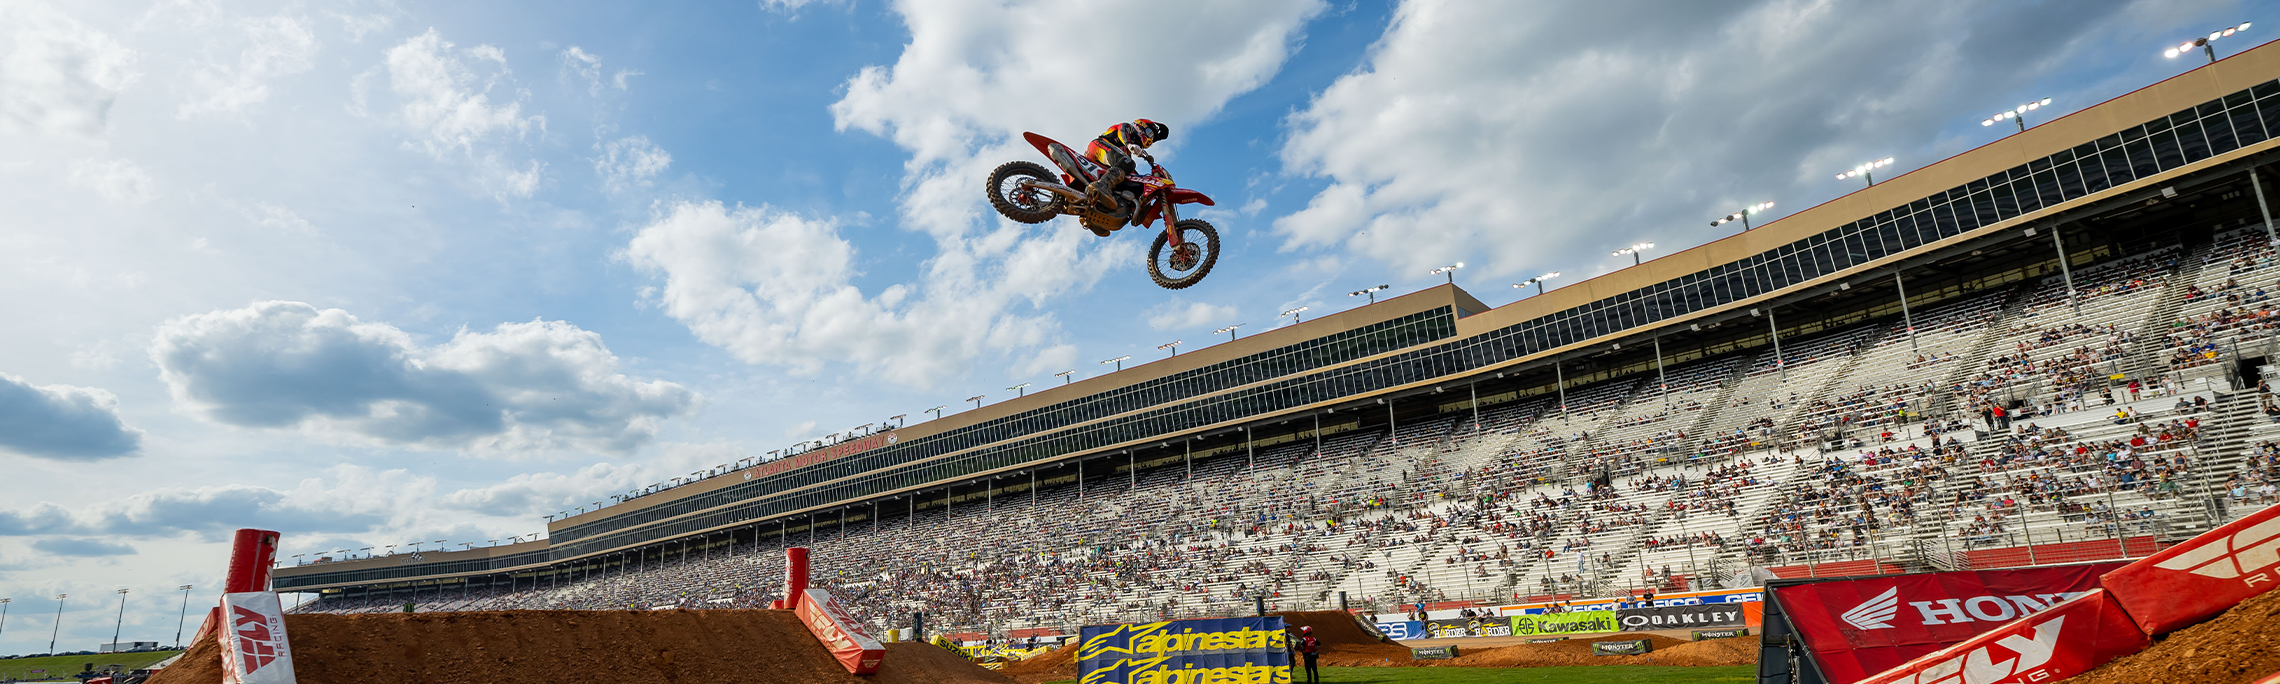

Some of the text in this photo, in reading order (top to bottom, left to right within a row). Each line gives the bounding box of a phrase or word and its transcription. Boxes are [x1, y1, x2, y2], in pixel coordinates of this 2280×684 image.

[754, 436, 885, 478] ATLANTA MOTOR SPEEDWAY
[1651, 611, 1739, 625] OAKLEY
[1909, 591, 2086, 626] HON
[1434, 627, 1467, 639] HARDER
[1474, 625, 1512, 638] HARDER
[1538, 617, 1612, 634] Kawasaki
[233, 604, 276, 675] FLY
[269, 616, 287, 658] RACING
[1136, 626, 1286, 662] alpinestars
[1601, 643, 1634, 651] MONSTER
[939, 639, 975, 662] SUZUKI
[1137, 662, 1292, 684] alpinestars
